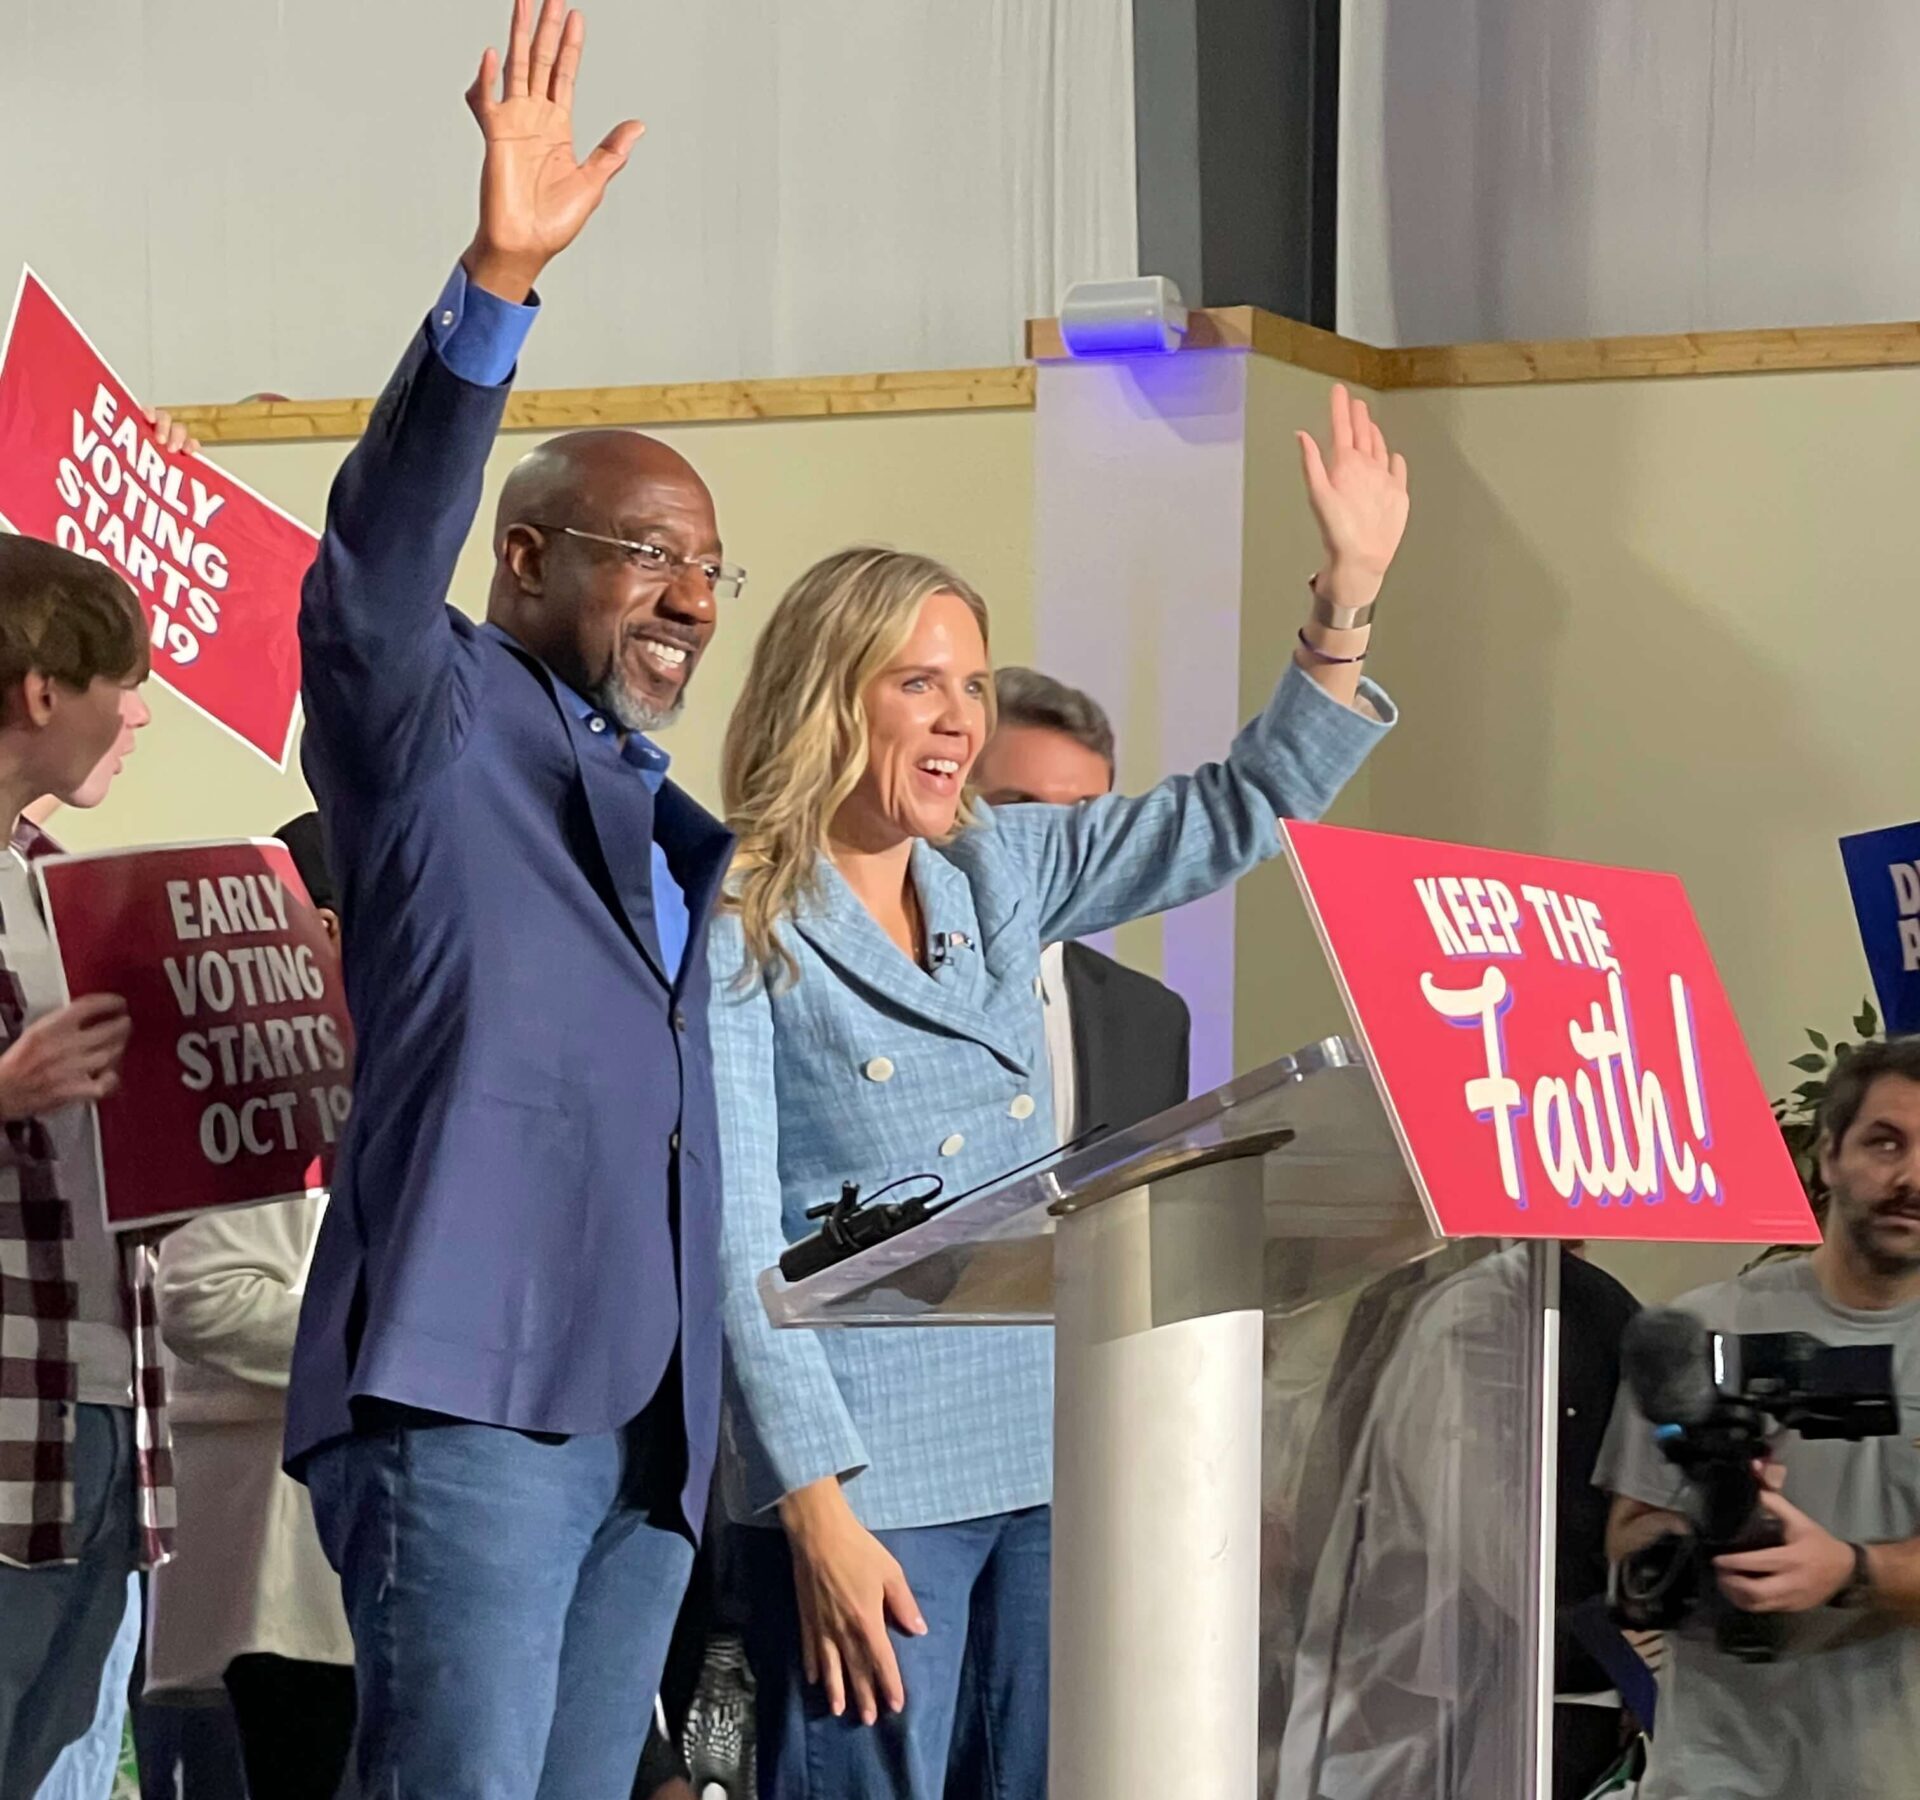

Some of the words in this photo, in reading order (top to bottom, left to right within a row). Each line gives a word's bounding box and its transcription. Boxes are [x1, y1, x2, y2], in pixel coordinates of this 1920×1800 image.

[91, 382, 225, 528] EARLY
[72, 408, 229, 590] VOTING
[56, 457, 219, 634] STARTS
[151, 604, 200, 664] 19
[166, 874, 289, 940] EARLY
[1413, 877, 1523, 956] KEEP
[1520, 883, 1622, 974] THE
[163, 944, 324, 1016] VOTING
[176, 1014, 345, 1090] STARTS
[1419, 966, 1717, 1200] Faith!
[200, 1091, 299, 1165] OCT
